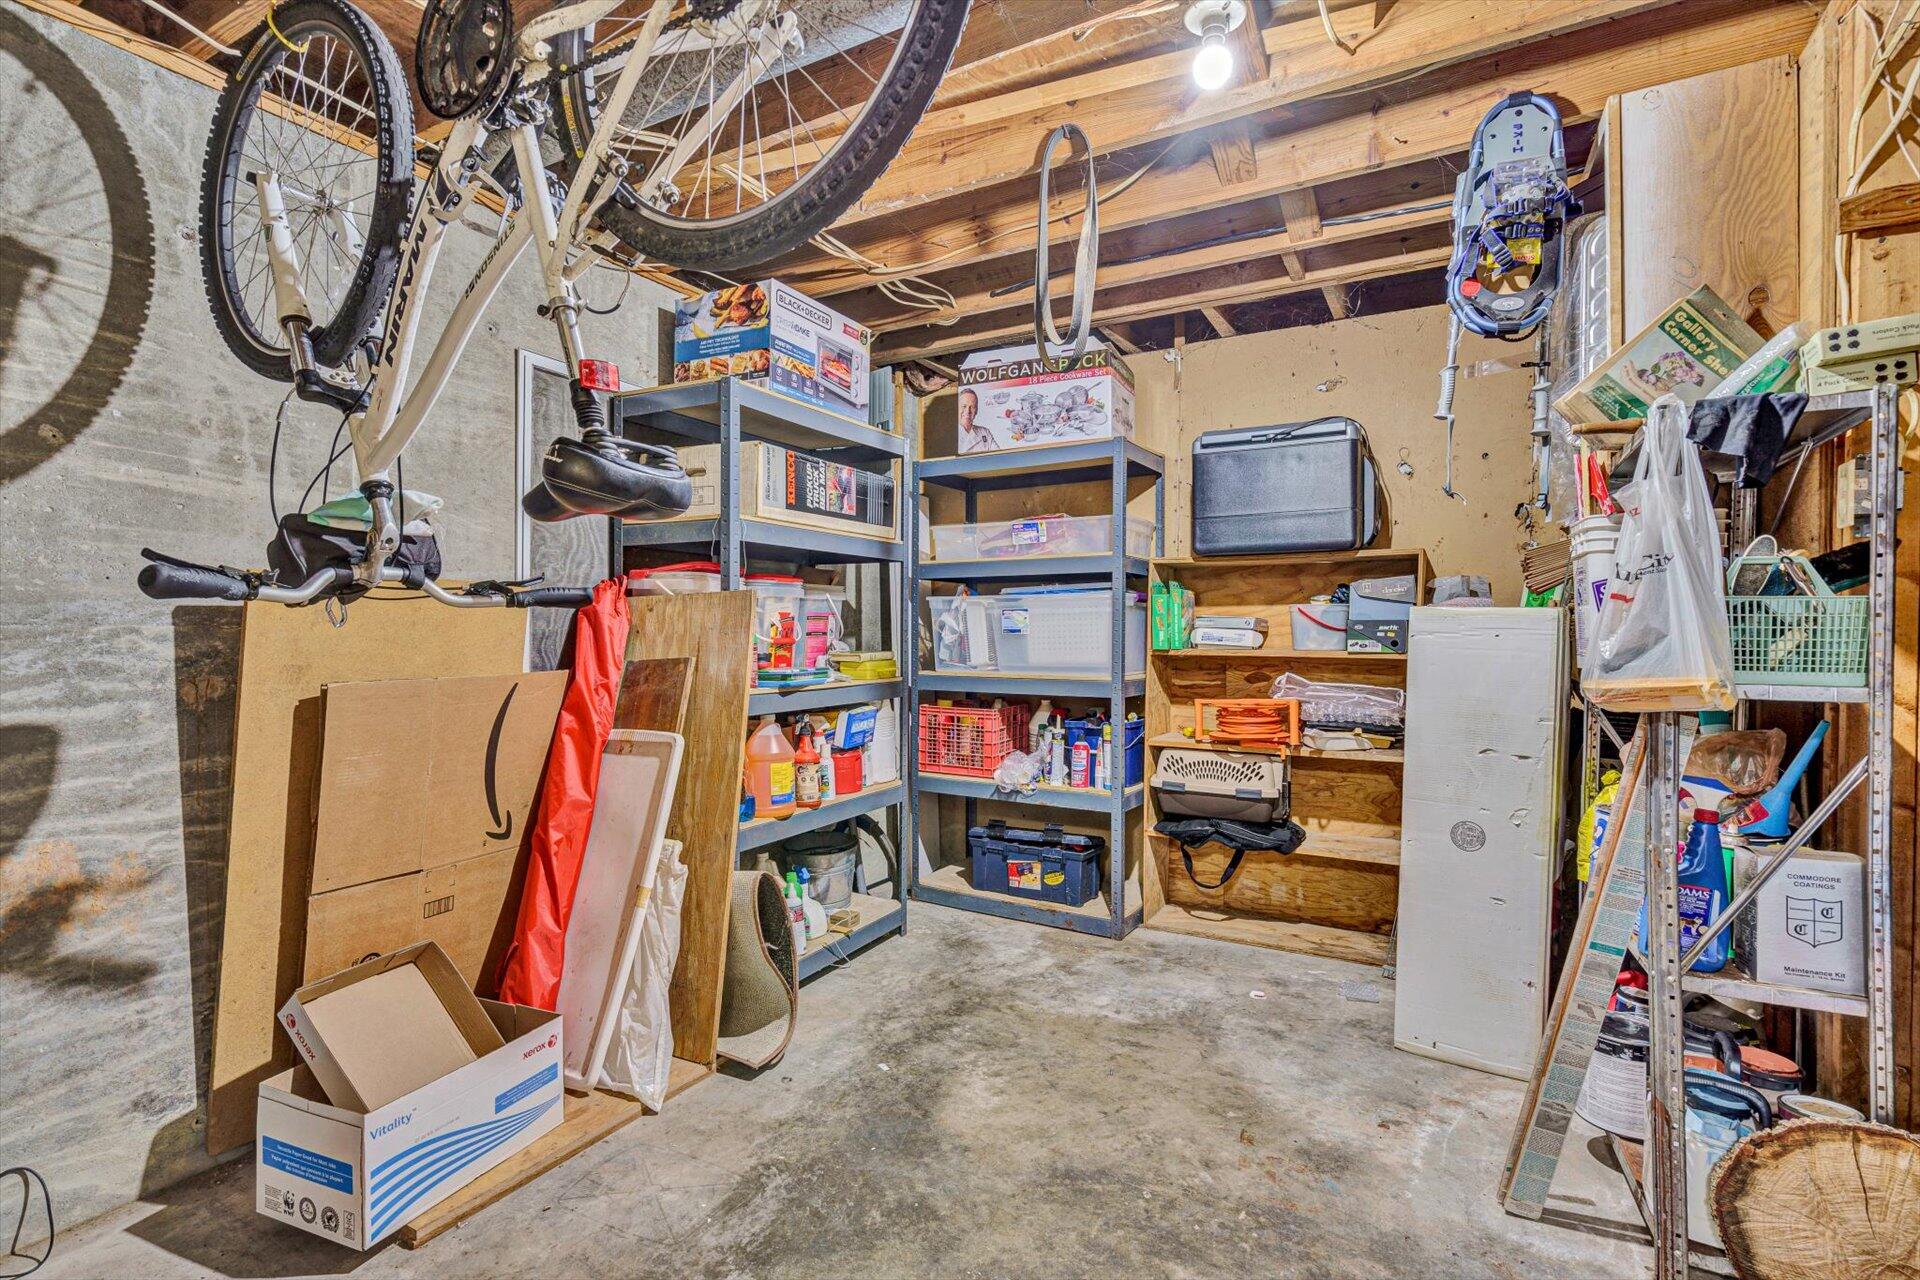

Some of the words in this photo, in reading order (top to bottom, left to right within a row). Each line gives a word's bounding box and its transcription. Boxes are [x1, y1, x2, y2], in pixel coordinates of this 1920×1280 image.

[473, 222, 516, 284] STINSON
[384, 219, 428, 368] MARIN
[779, 294, 830, 325] BLACK+DECKER
[1664, 320, 1703, 356] Corner
[1675, 311, 1719, 352] Gallery
[1059, 353, 1106, 371] PCK
[1028, 377, 1038, 385] 18
[1040, 374, 1058, 383] Piece
[1060, 371, 1093, 381] Cookware
[1094, 368, 1107, 376] Set
[806, 462, 814, 509] PICKUP
[812, 468, 820, 508] TRUCK
[1787, 873, 1842, 883] COMMODORE
[1793, 881, 1836, 890] COATINGS
[1678, 886, 1710, 899] DAMS
[1784, 966, 1833, 977] Maintenance
[295, 1032, 316, 1061] xerox
[522, 1042, 546, 1060] xerox
[370, 1112, 412, 1140] Vitality
